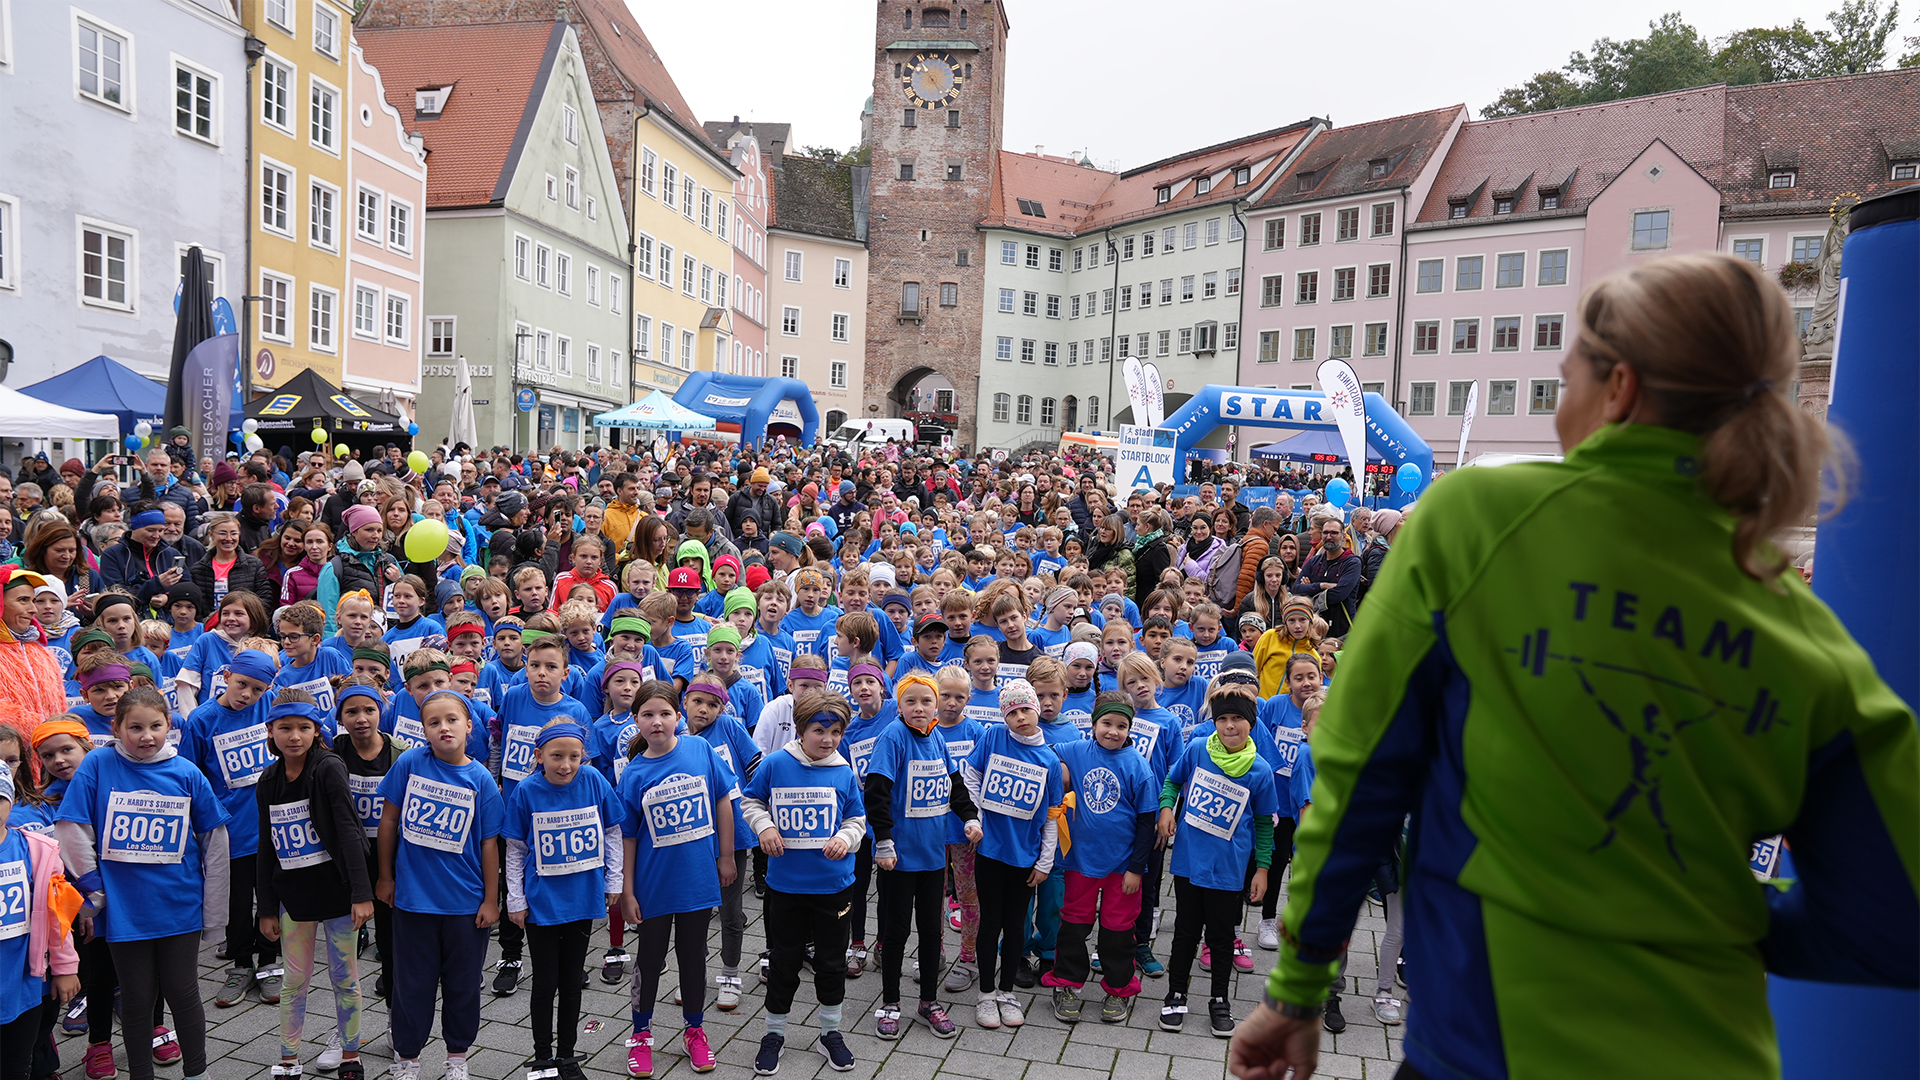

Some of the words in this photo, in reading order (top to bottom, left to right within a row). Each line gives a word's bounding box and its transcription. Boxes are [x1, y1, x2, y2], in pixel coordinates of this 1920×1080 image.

[422, 364, 494, 377] PFISTREI
[1124, 435, 1139, 445] lauf
[1134, 428, 1154, 438] stadt
[1120, 449, 1171, 465] STARTBLOCK
[1130, 465, 1154, 489] A
[1569, 581, 1755, 670] TEAM
[228, 732, 249, 744] HARDY'S
[1000, 761, 1019, 771] HARDY'S
[420, 782, 443, 796] HARDY'S
[444, 789, 473, 802] STADTLAUF
[655, 786, 677, 798] HARDY'S
[677, 780, 702, 793] STADTLAUF
[775, 792, 784, 800] 17.
[806, 791, 832, 799] STADTLAUF
[912, 775, 949, 801] 8269
[987, 772, 1039, 805] 8305
[115, 797, 126, 806] 17.
[126, 798, 154, 808] HARDY'S
[155, 800, 185, 810] STADTLAUF
[652, 795, 704, 829] 8327
[1189, 786, 1238, 823] 8234
[406, 797, 467, 834] 8240
[546, 815, 570, 824] HARDY'S
[570, 810, 597, 822] STADTLAUF
[778, 806, 830, 831] 8031
[112, 814, 180, 844] 8061
[270, 820, 321, 851] 8196
[126, 842, 140, 850] Lea
[140, 843, 164, 852] Sophie
[540, 827, 598, 858] 8163
